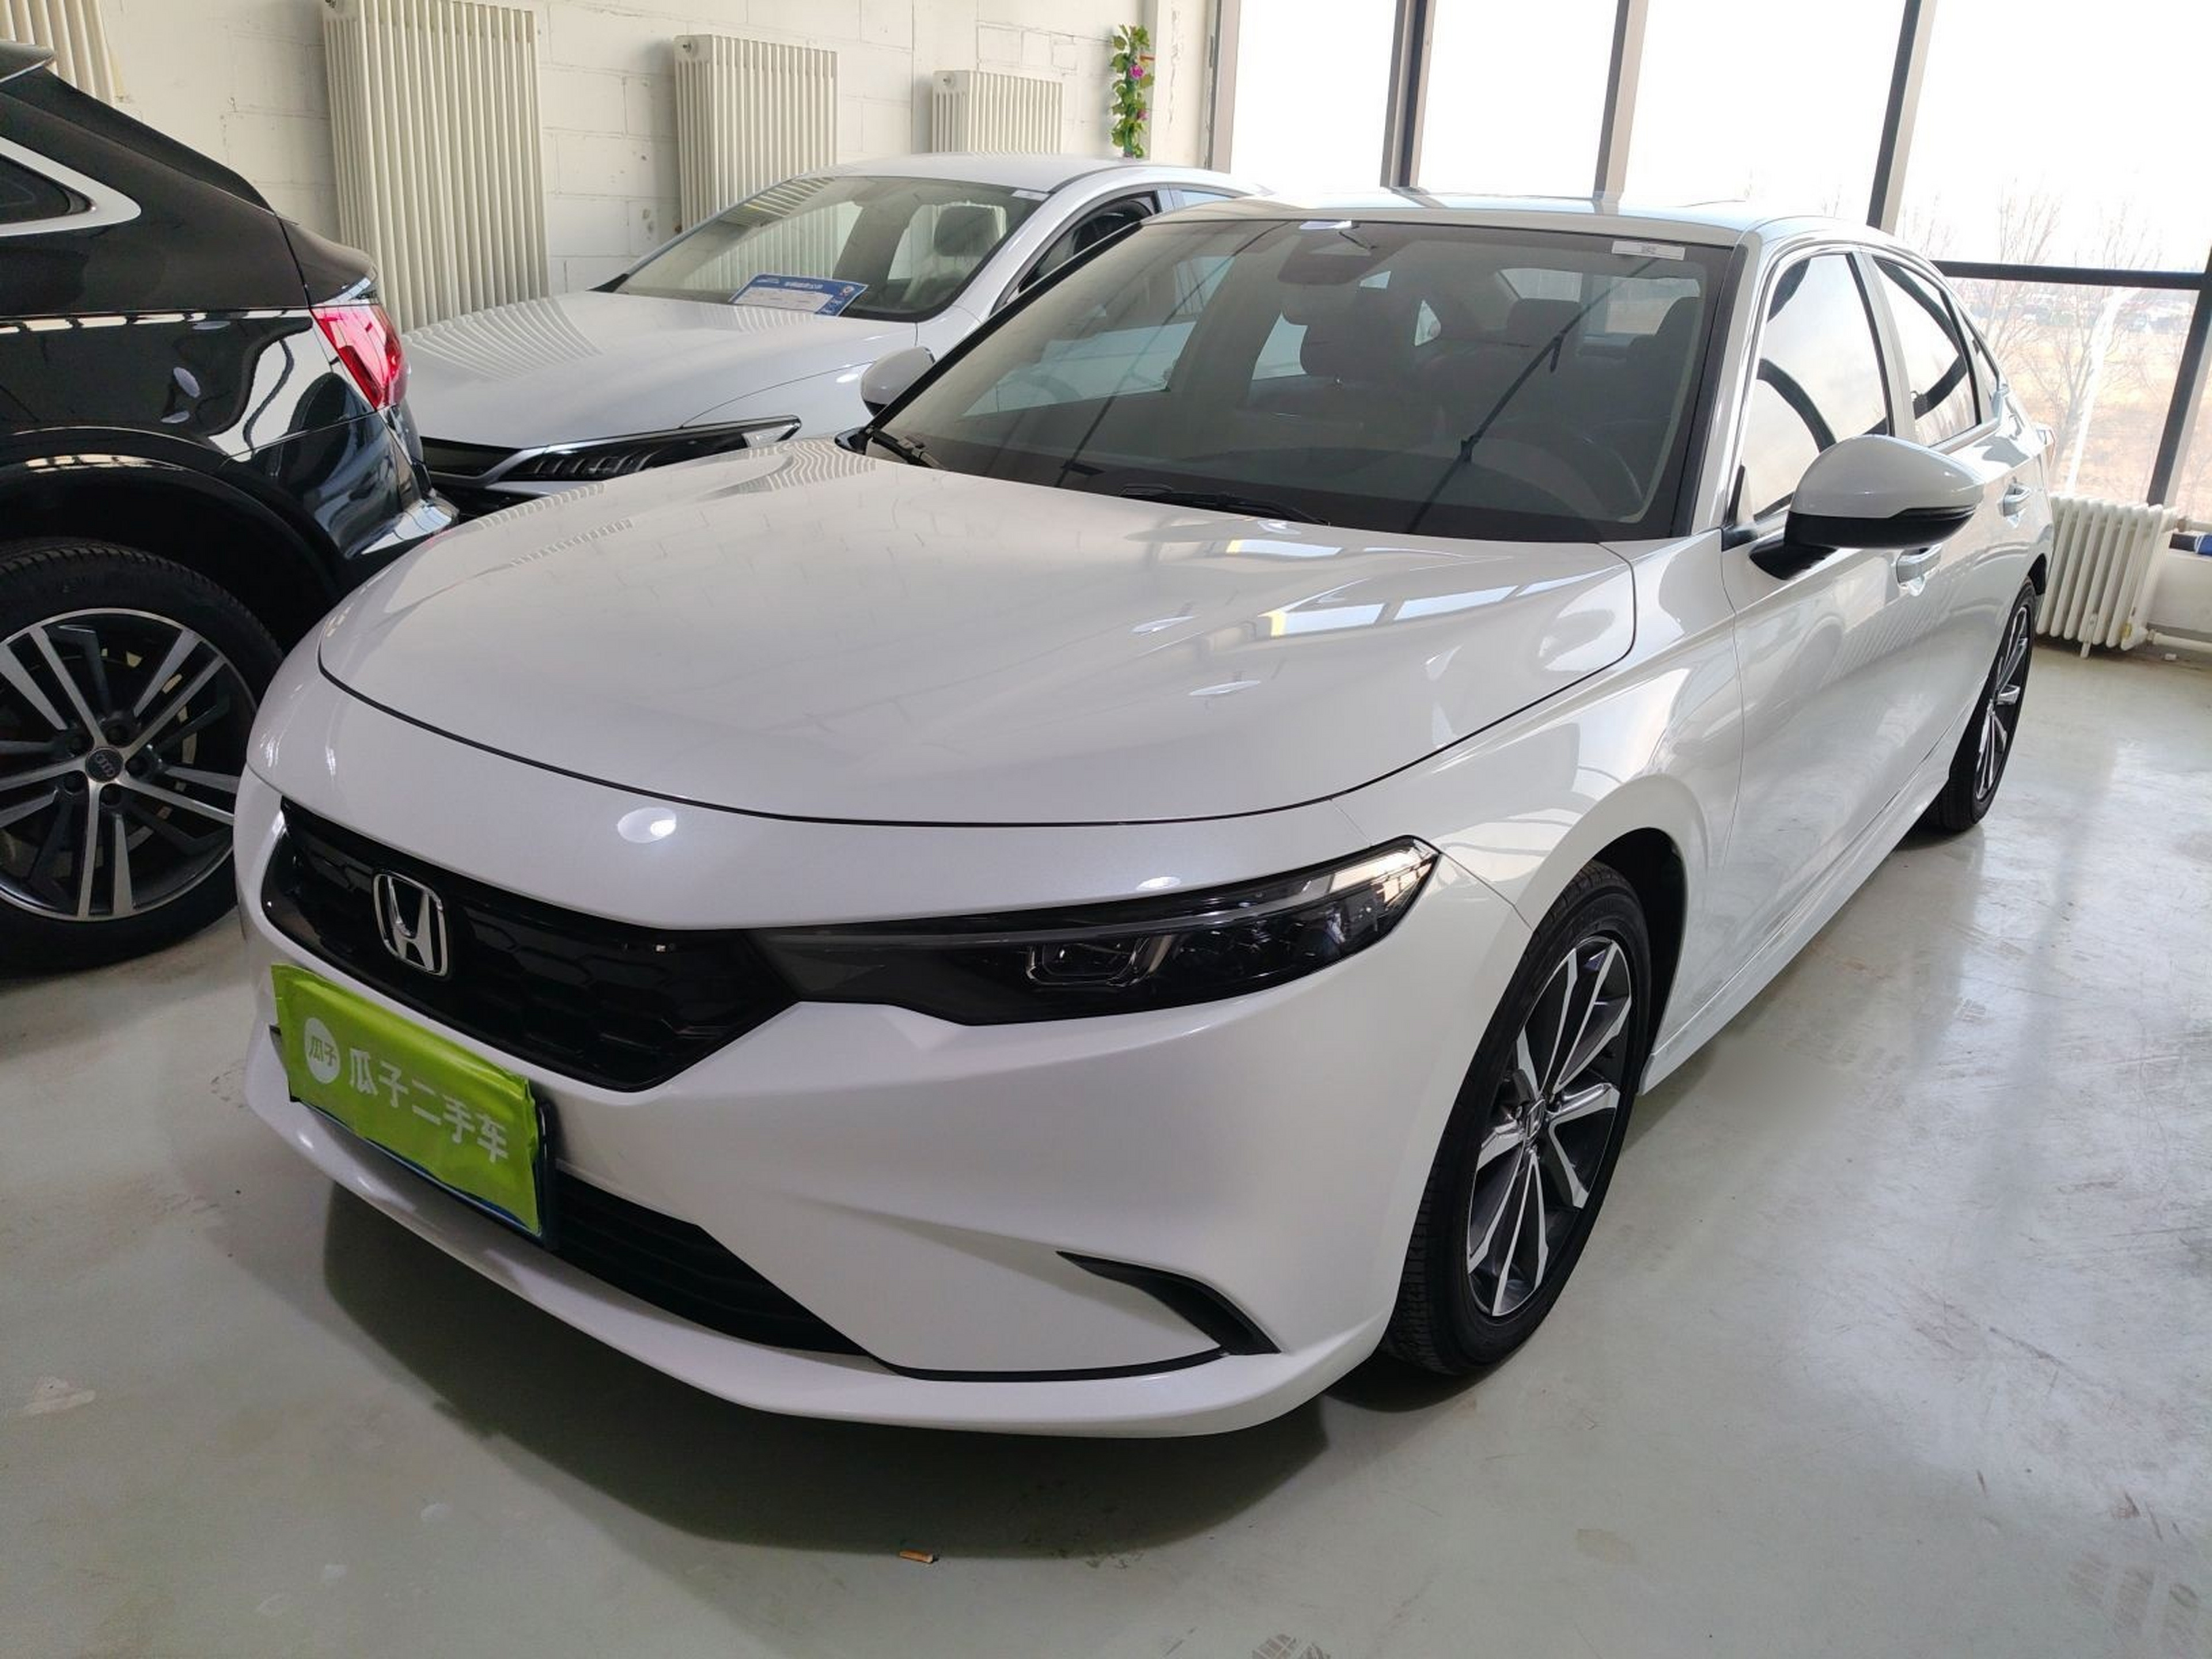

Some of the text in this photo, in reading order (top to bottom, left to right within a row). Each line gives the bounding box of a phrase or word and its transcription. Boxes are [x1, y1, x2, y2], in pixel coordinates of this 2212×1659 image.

[309, 1036, 336, 1066] 瓜子
[350, 1049, 507, 1162] 瓜子二手车
